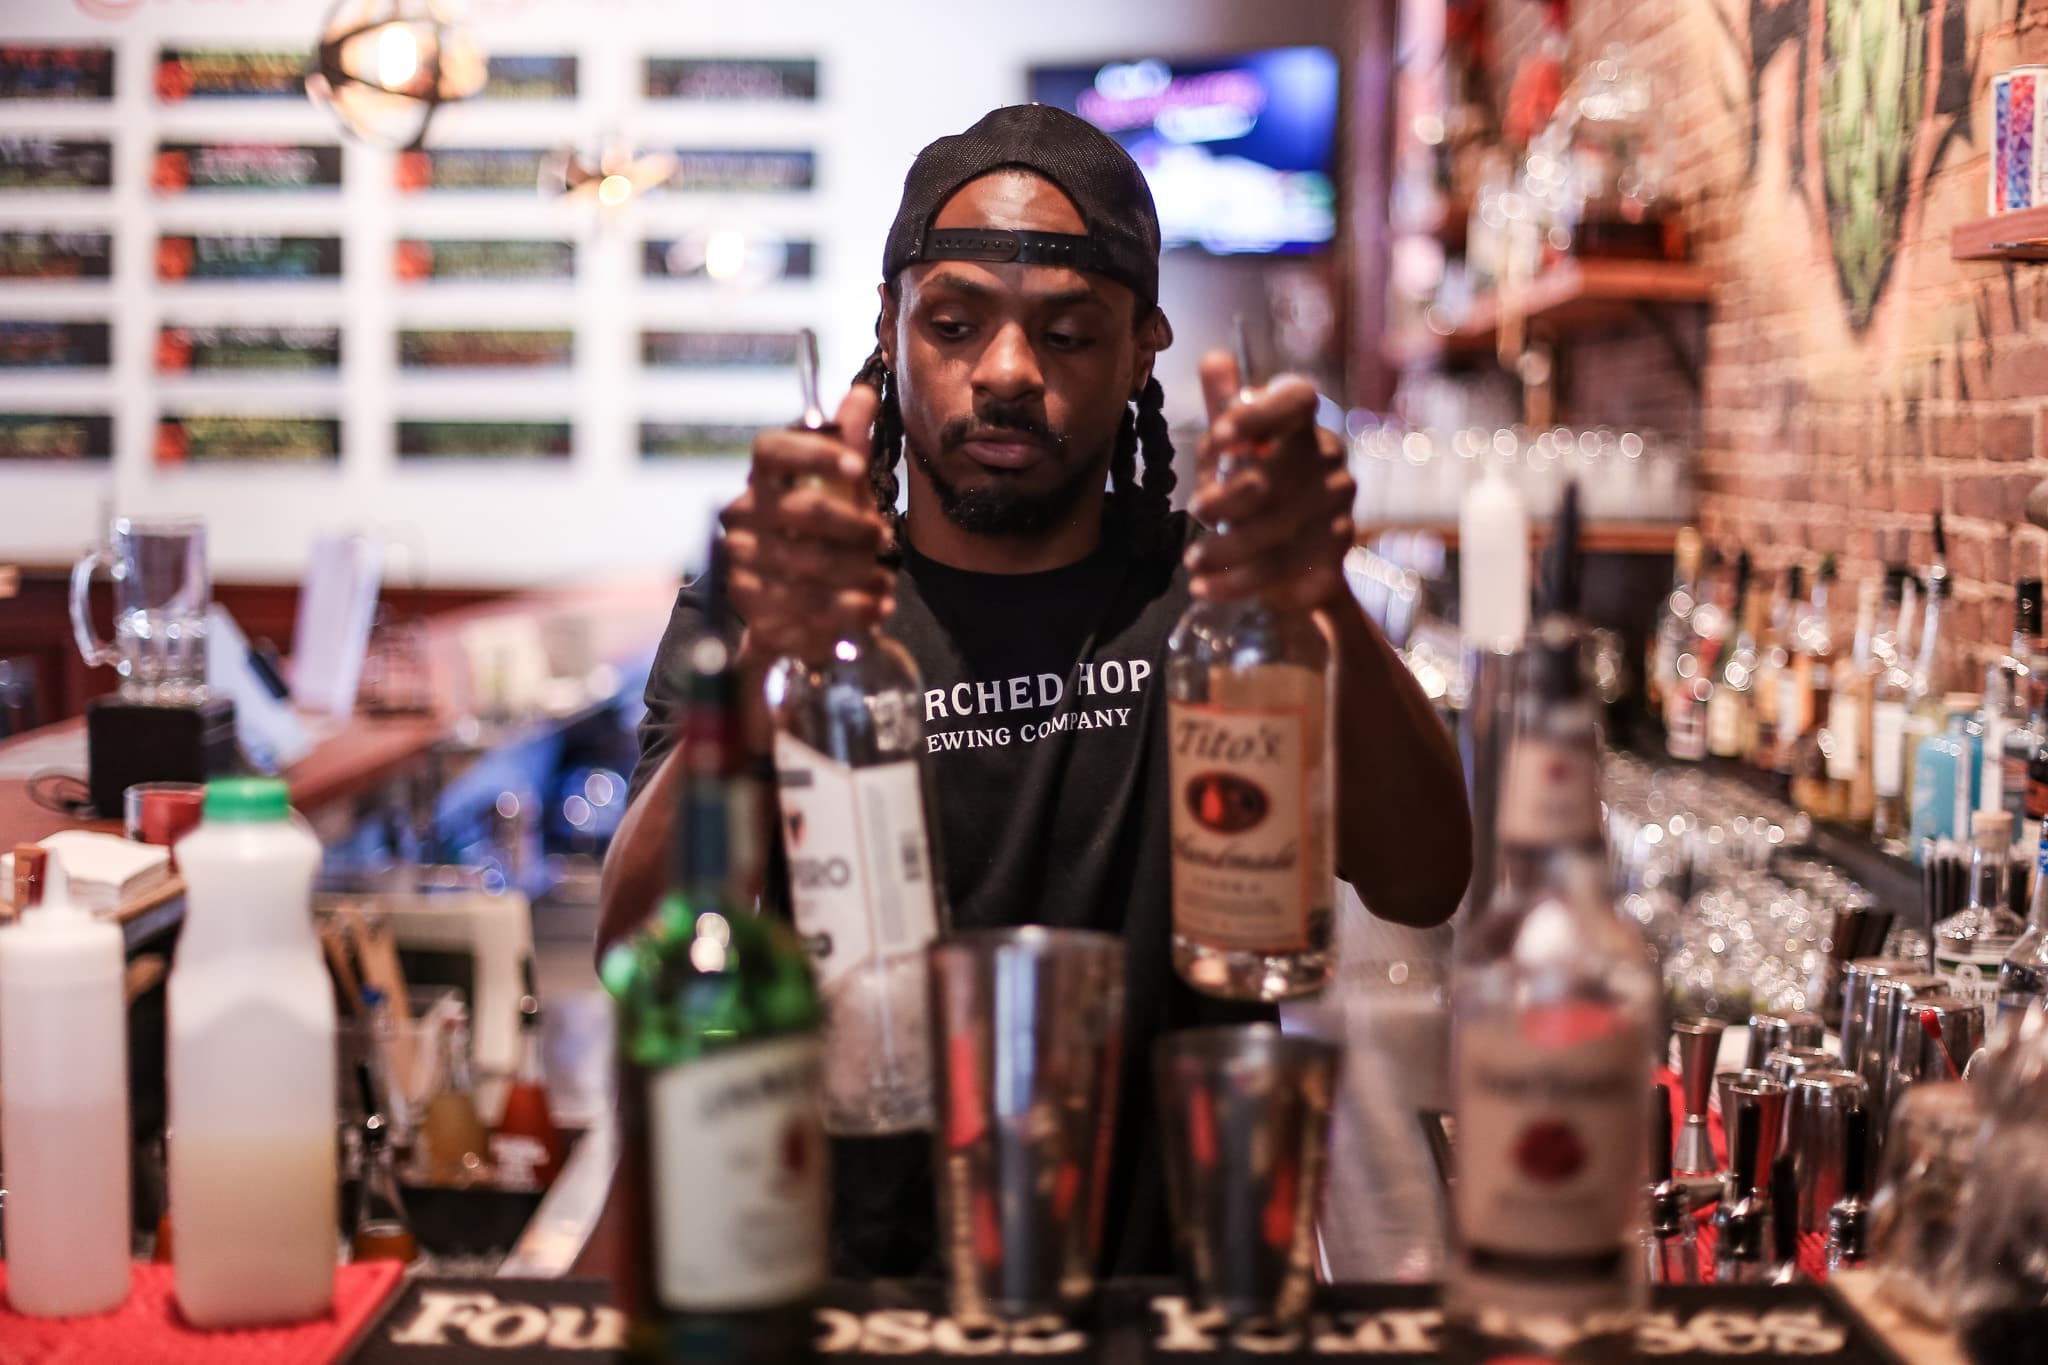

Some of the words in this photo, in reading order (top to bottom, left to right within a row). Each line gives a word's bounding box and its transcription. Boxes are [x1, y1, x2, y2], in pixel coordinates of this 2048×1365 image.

[924, 673, 1064, 722] RCHED
[1077, 659, 1151, 696] HOP
[926, 727, 1011, 753] EWING
[1020, 708, 1131, 743] COMPANY
[1177, 717, 1282, 766] Tito's
